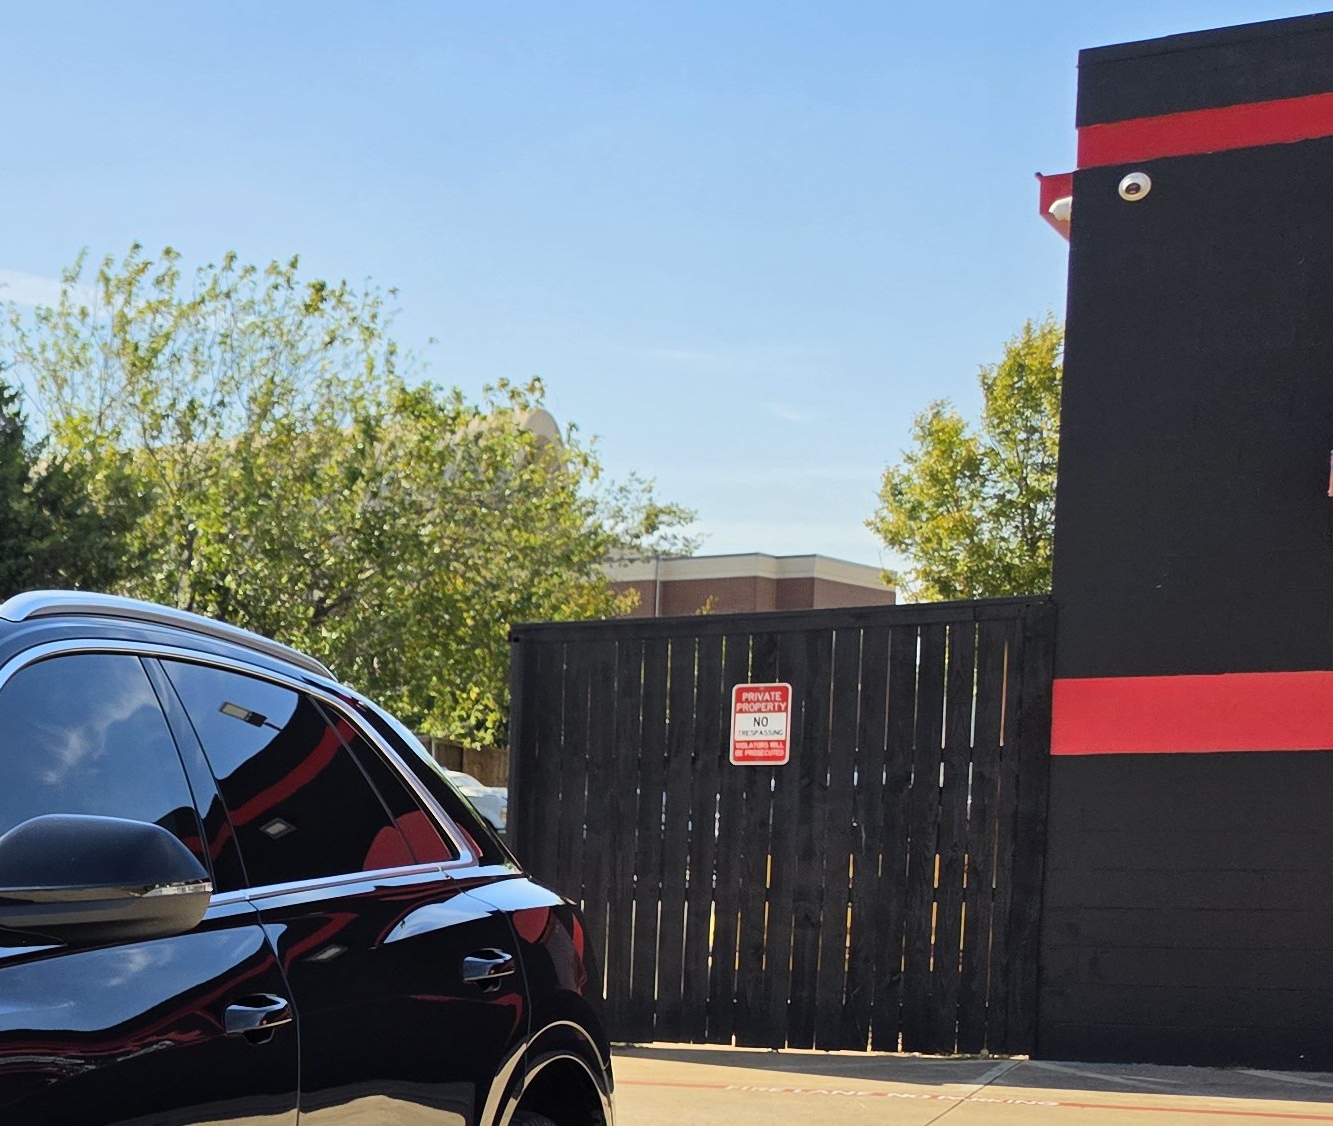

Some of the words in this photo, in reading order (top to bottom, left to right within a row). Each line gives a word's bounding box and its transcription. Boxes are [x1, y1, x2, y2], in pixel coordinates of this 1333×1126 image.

[742, 691, 782, 702] PRIVATE
[736, 702, 787, 712] PROPERTY
[753, 716, 769, 728] NO
[738, 729, 783, 737] TRESPASSING
